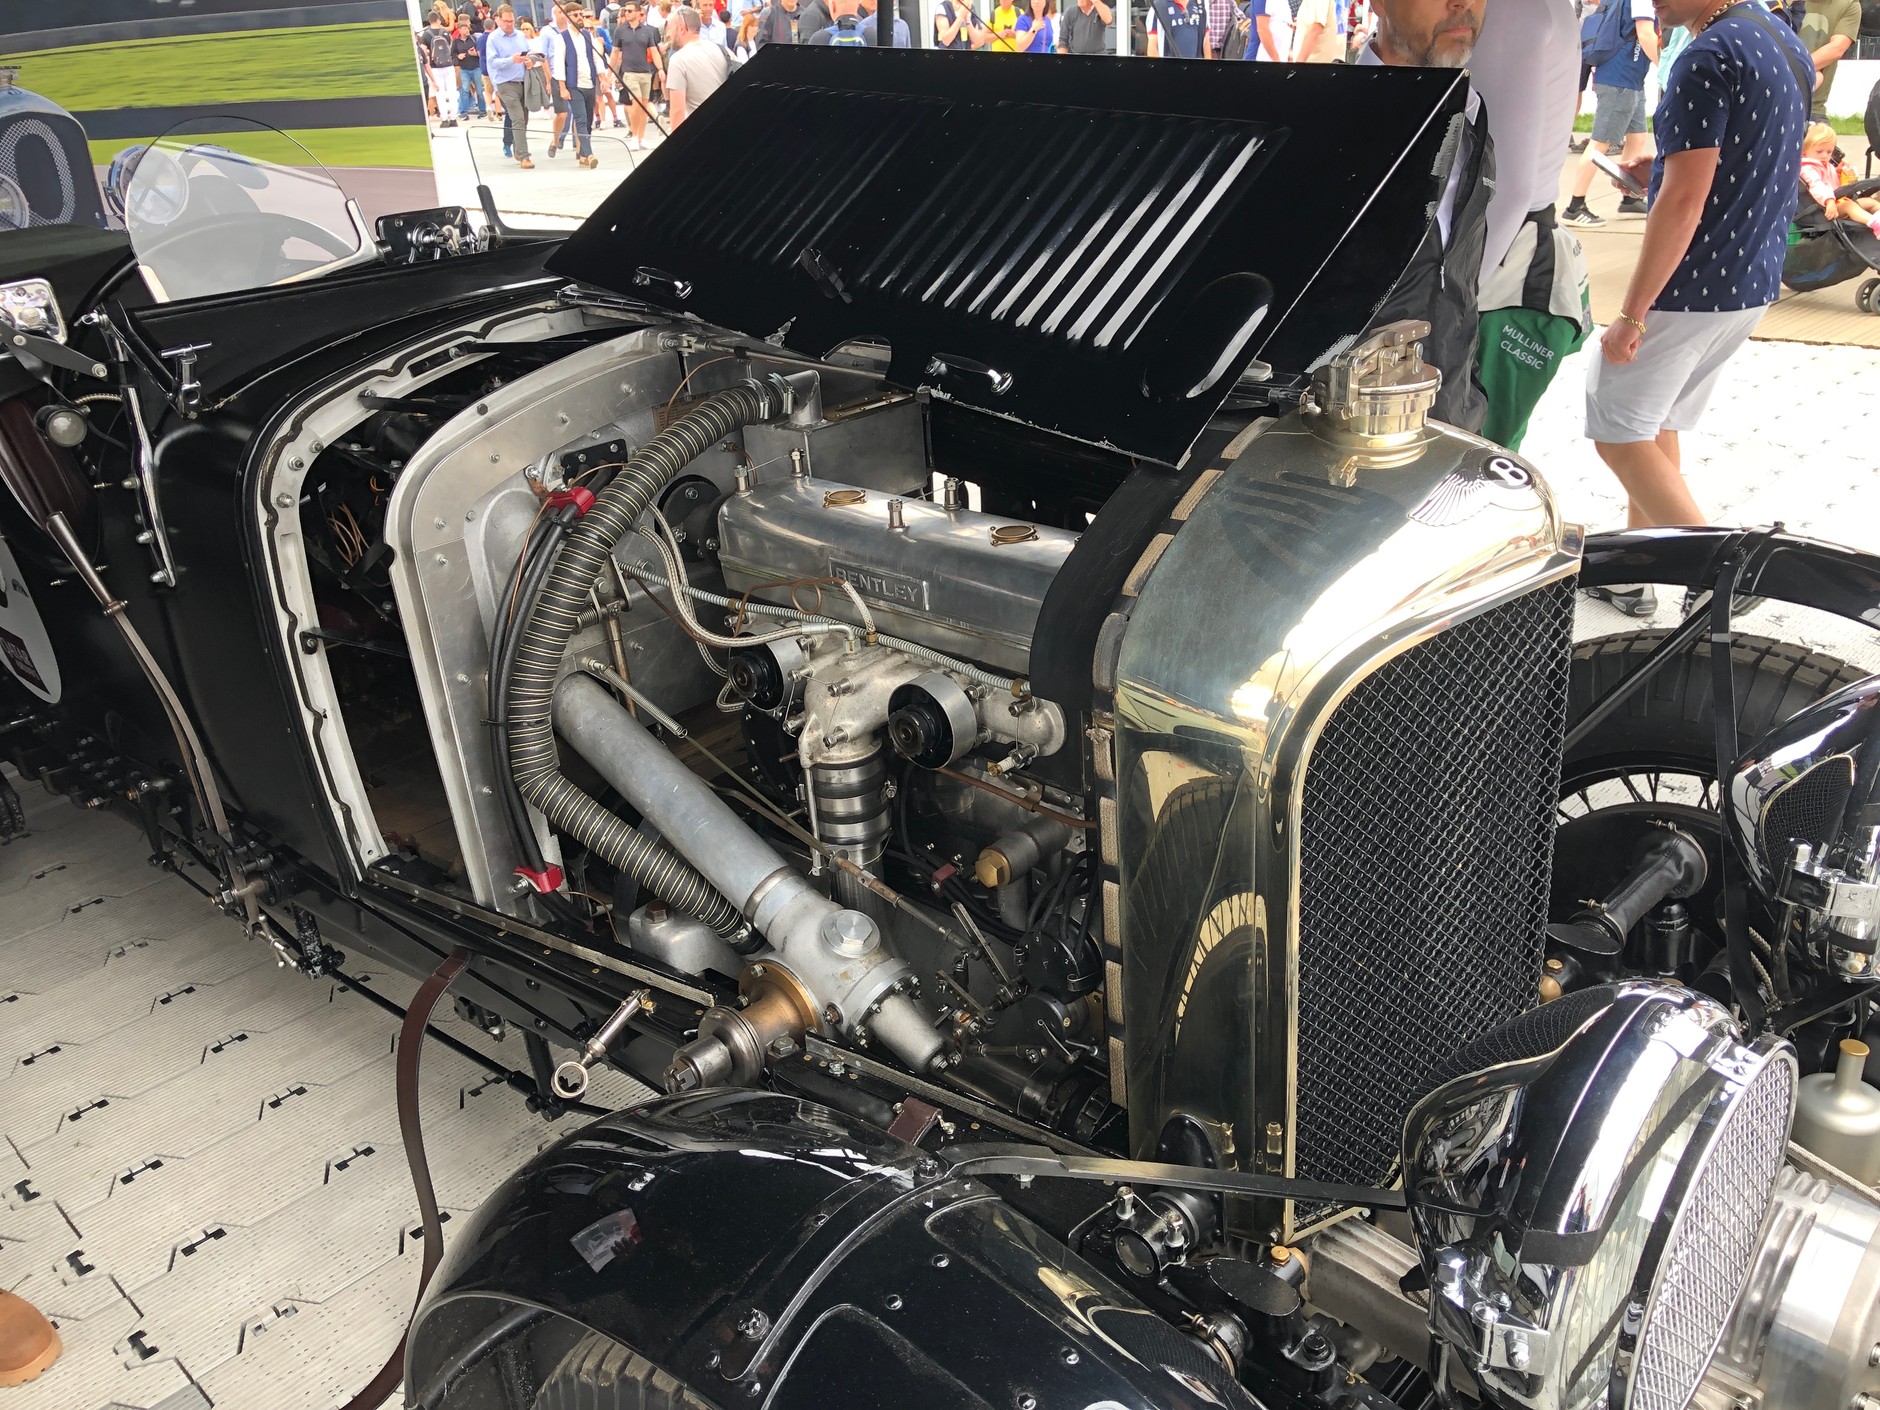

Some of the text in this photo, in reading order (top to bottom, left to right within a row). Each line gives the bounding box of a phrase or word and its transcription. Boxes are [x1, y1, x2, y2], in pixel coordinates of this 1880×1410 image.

[1500, 340, 1544, 370] CLASSIC
[1502, 324, 1555, 361] MULLINER
[1489, 457, 1529, 487] B
[835, 566, 918, 602] BENTLEY
